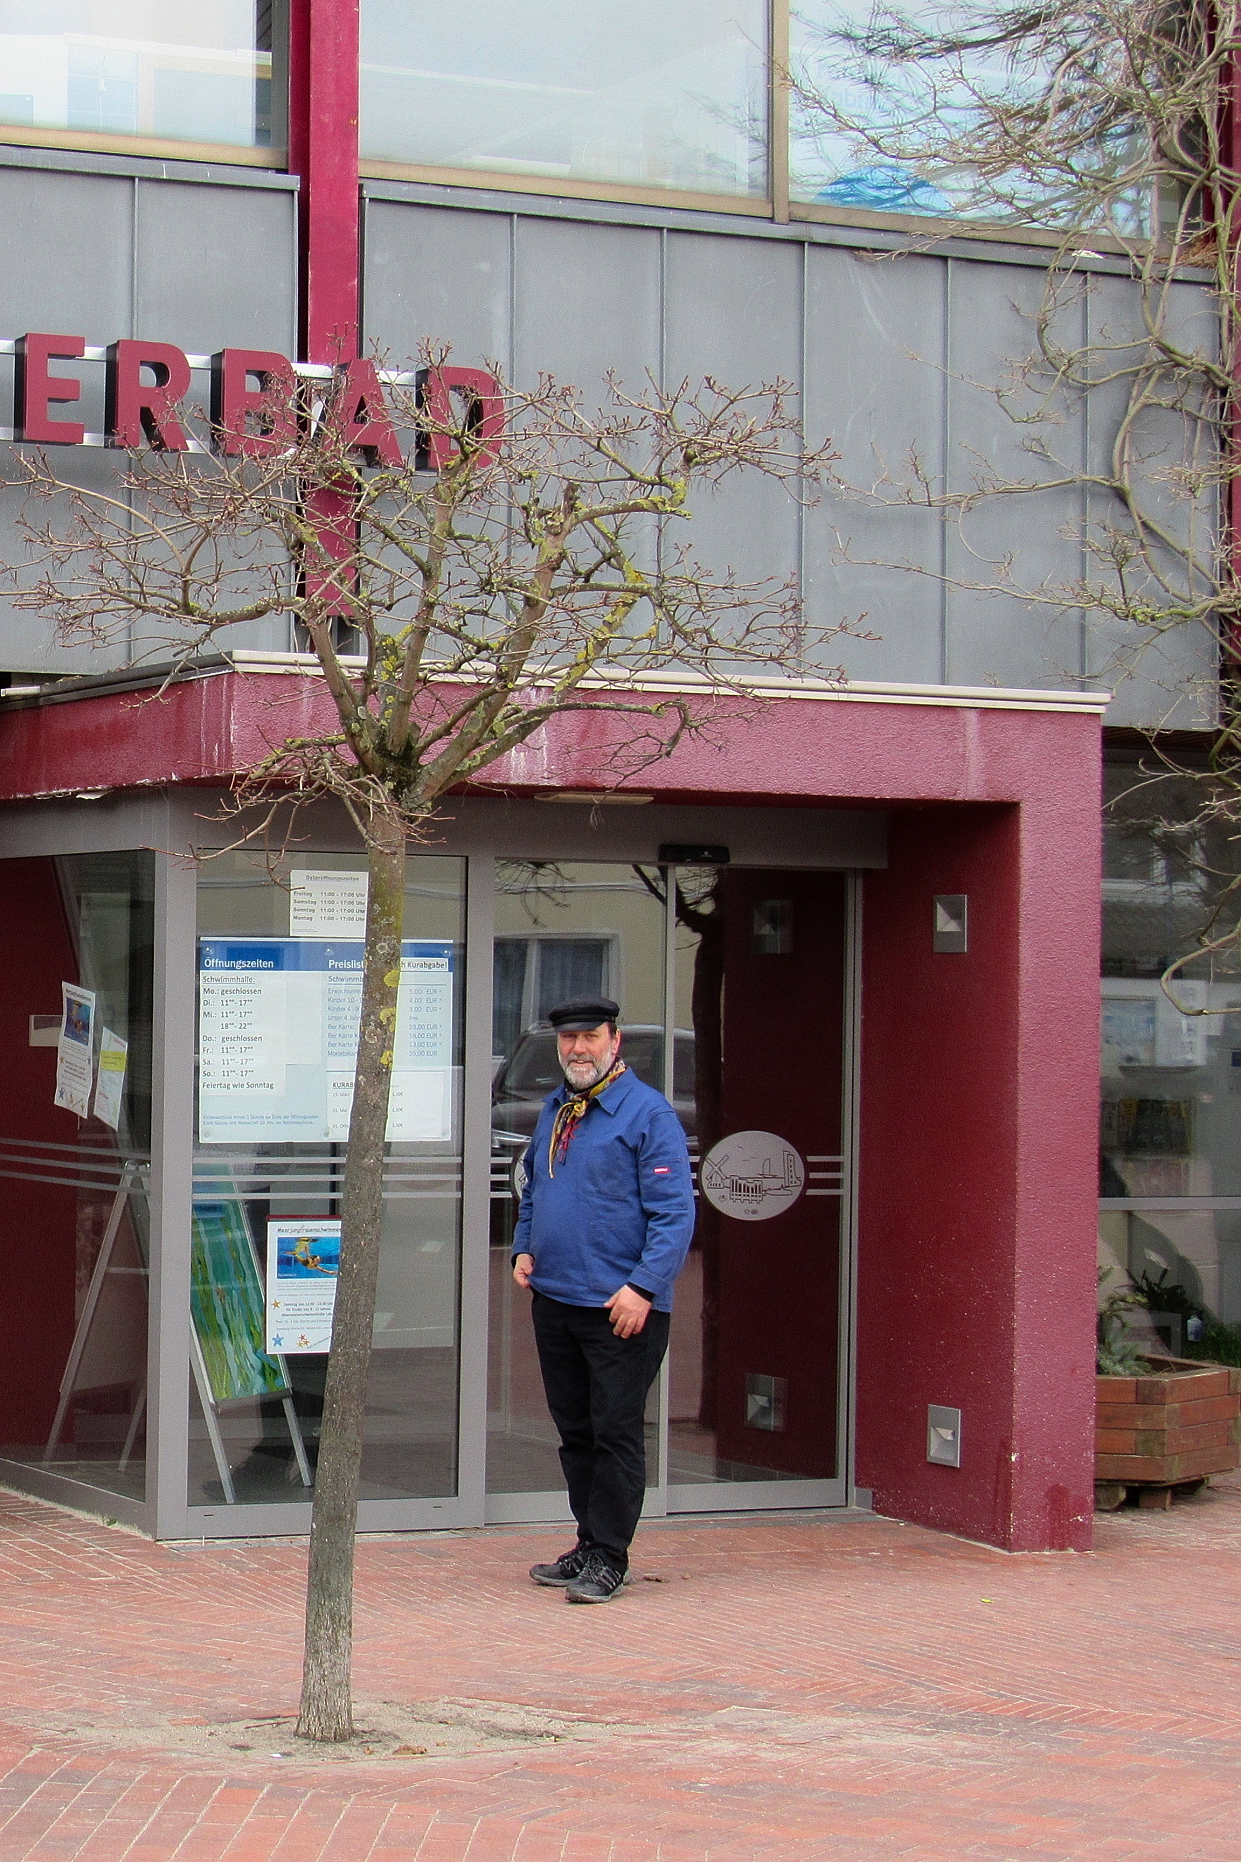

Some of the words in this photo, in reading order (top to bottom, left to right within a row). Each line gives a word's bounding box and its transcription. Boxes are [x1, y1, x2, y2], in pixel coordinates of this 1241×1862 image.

[204, 956, 274, 969] Öffnungszeiten
[329, 959, 365, 968] Preislist
[221, 988, 262, 996] geschlossen
[222, 1035, 262, 1043] geschlossen
